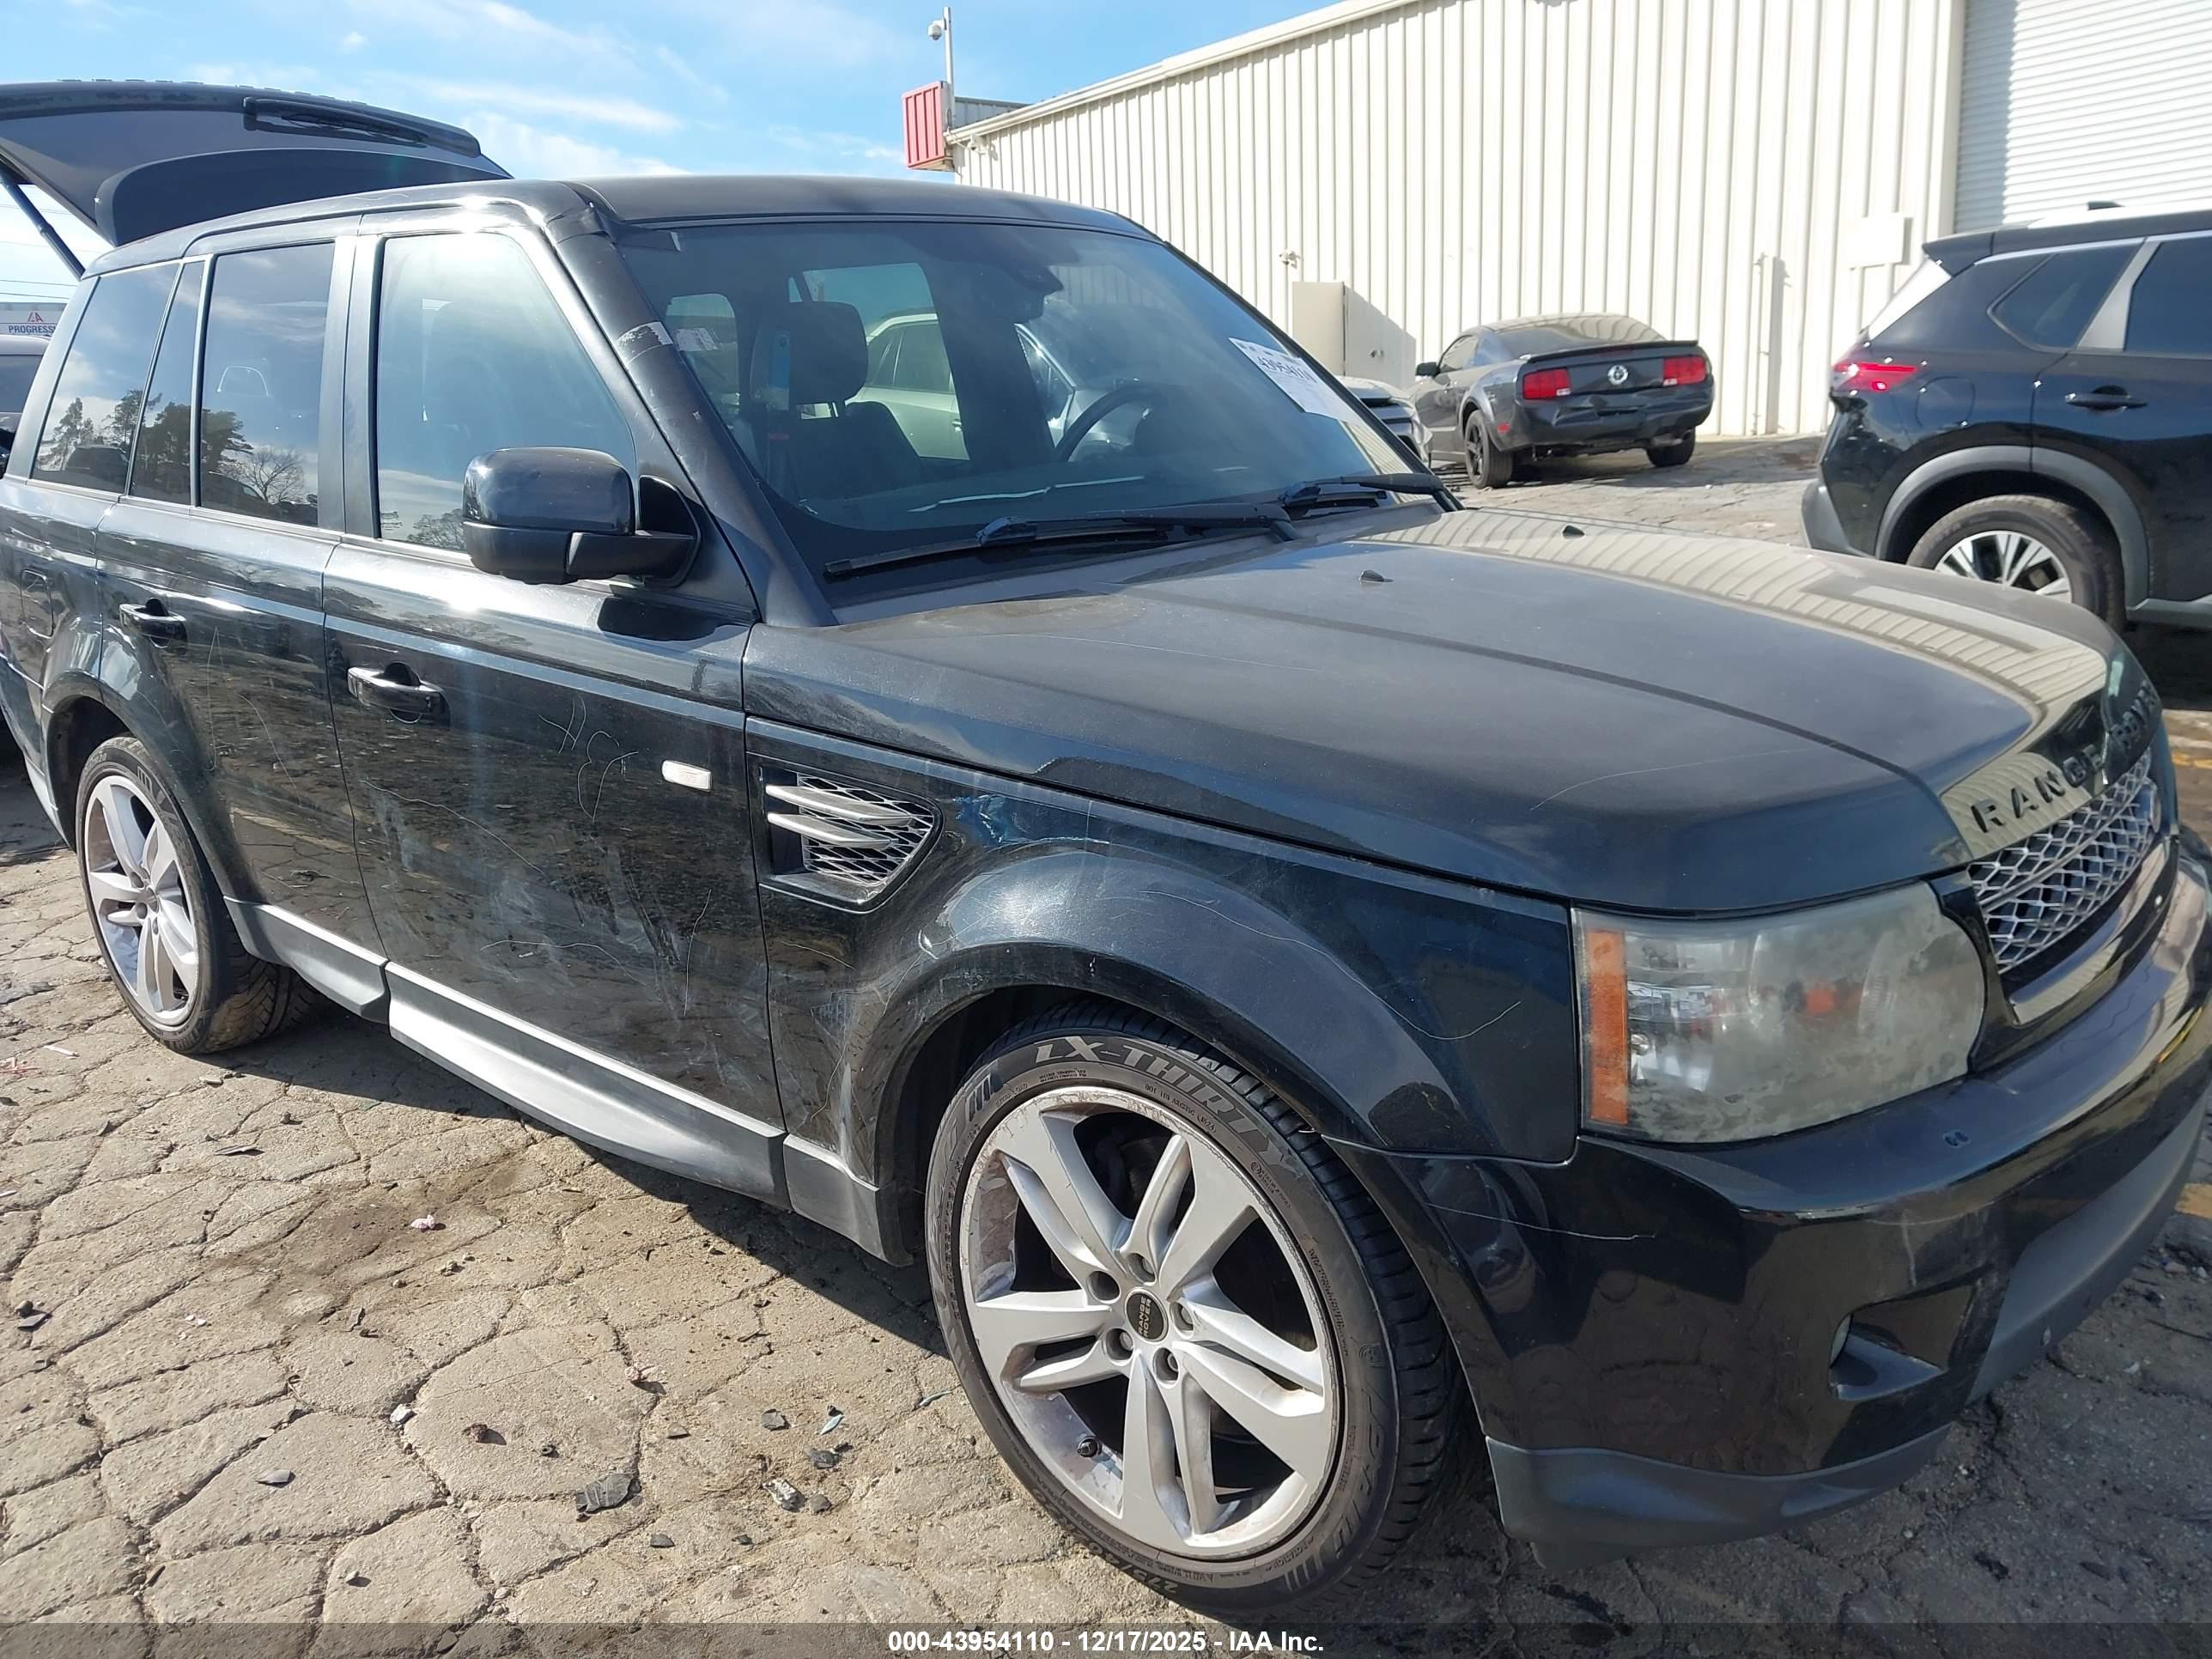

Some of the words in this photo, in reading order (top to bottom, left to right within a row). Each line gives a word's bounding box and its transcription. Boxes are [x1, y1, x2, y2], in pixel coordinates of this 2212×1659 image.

[1971, 744, 2104, 834] RANGE
[1034, 1036, 1303, 1177] LX-THIRTY
[1138, 1296, 1146, 1334] RANGE
[1143, 1298, 1152, 1338] ROVER
